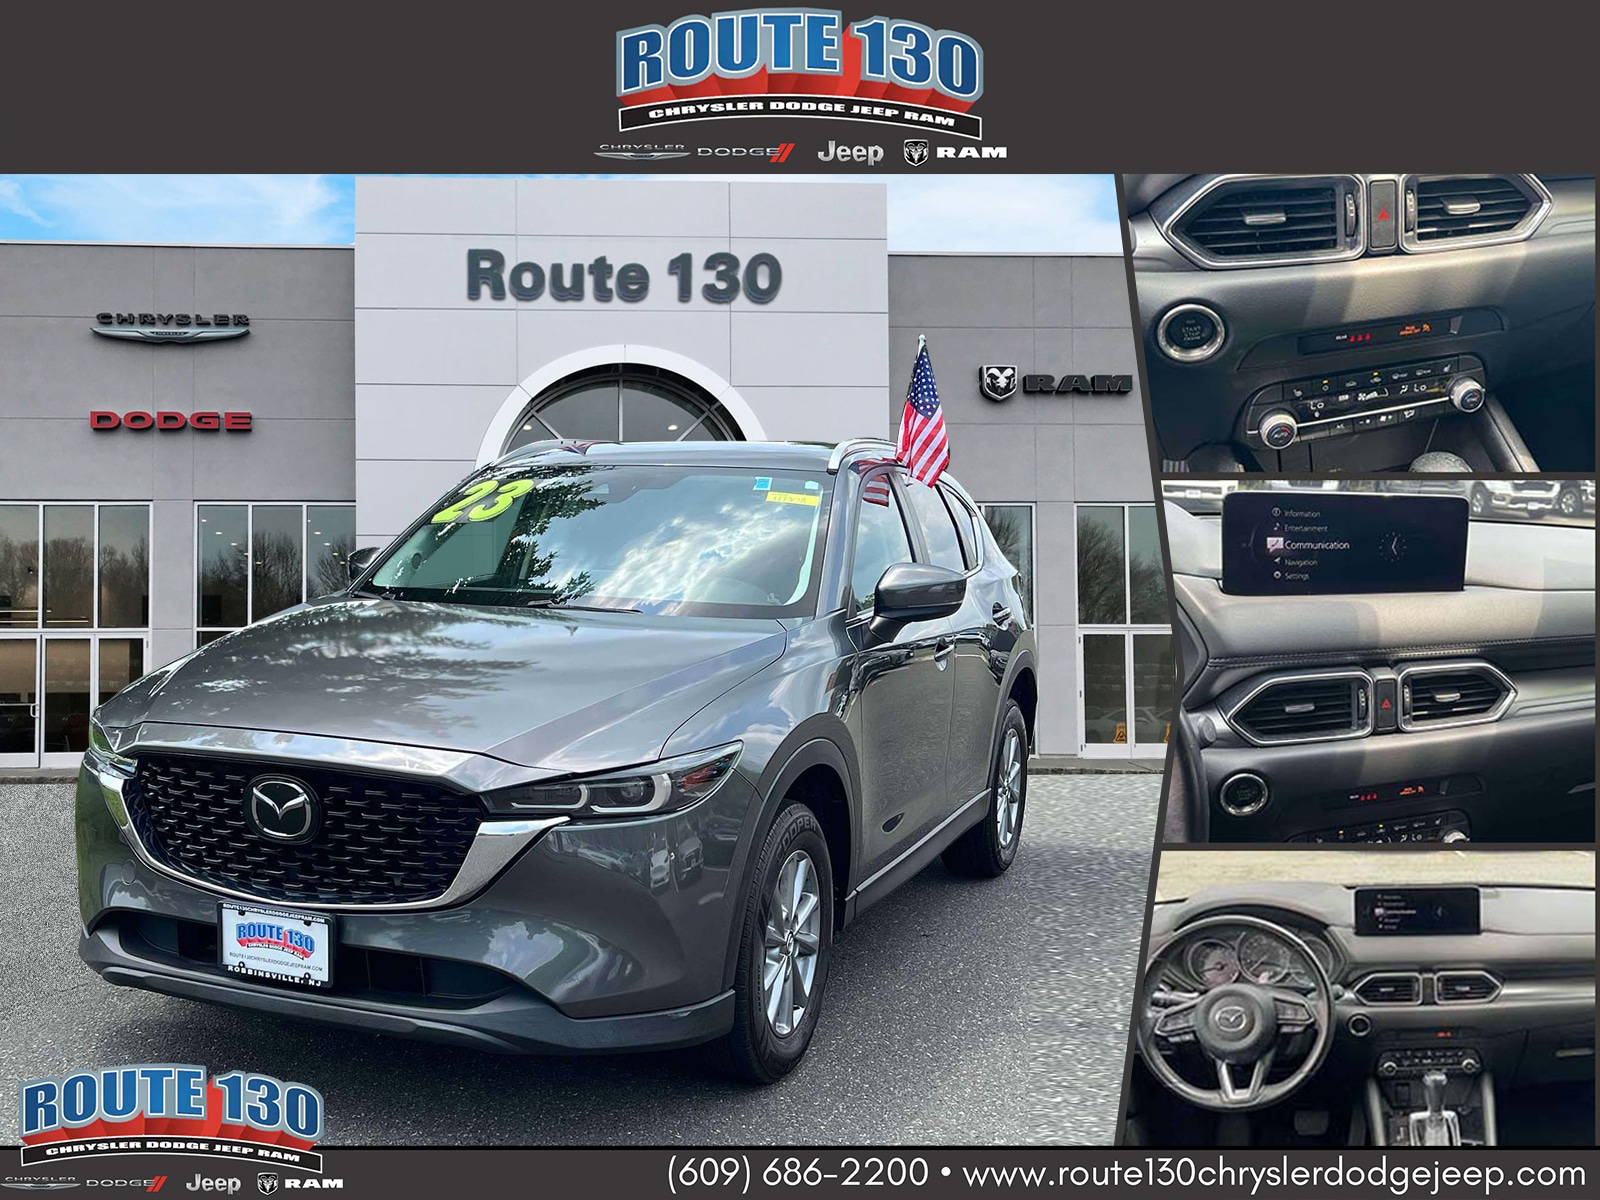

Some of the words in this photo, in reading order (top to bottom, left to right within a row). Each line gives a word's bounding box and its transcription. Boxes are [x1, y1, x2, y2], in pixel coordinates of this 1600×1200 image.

[467, 248, 650, 302] Route
[668, 252, 783, 303] 130
[96, 312, 250, 326] CHRYSLER
[1022, 374, 1133, 394] RAM
[90, 411, 252, 432] DODGE
[431, 479, 535, 524] 23
[1284, 509, 1321, 518] Information
[1284, 524, 1329, 532] Entertainment
[1284, 540, 1350, 550] Communication
[1284, 558, 1318, 567] Navigation
[1284, 571, 1310, 580] Settings
[236, 922, 285, 941] ROUTE
[286, 928, 315, 953] 130
[308, 979, 322, 987] NJ
